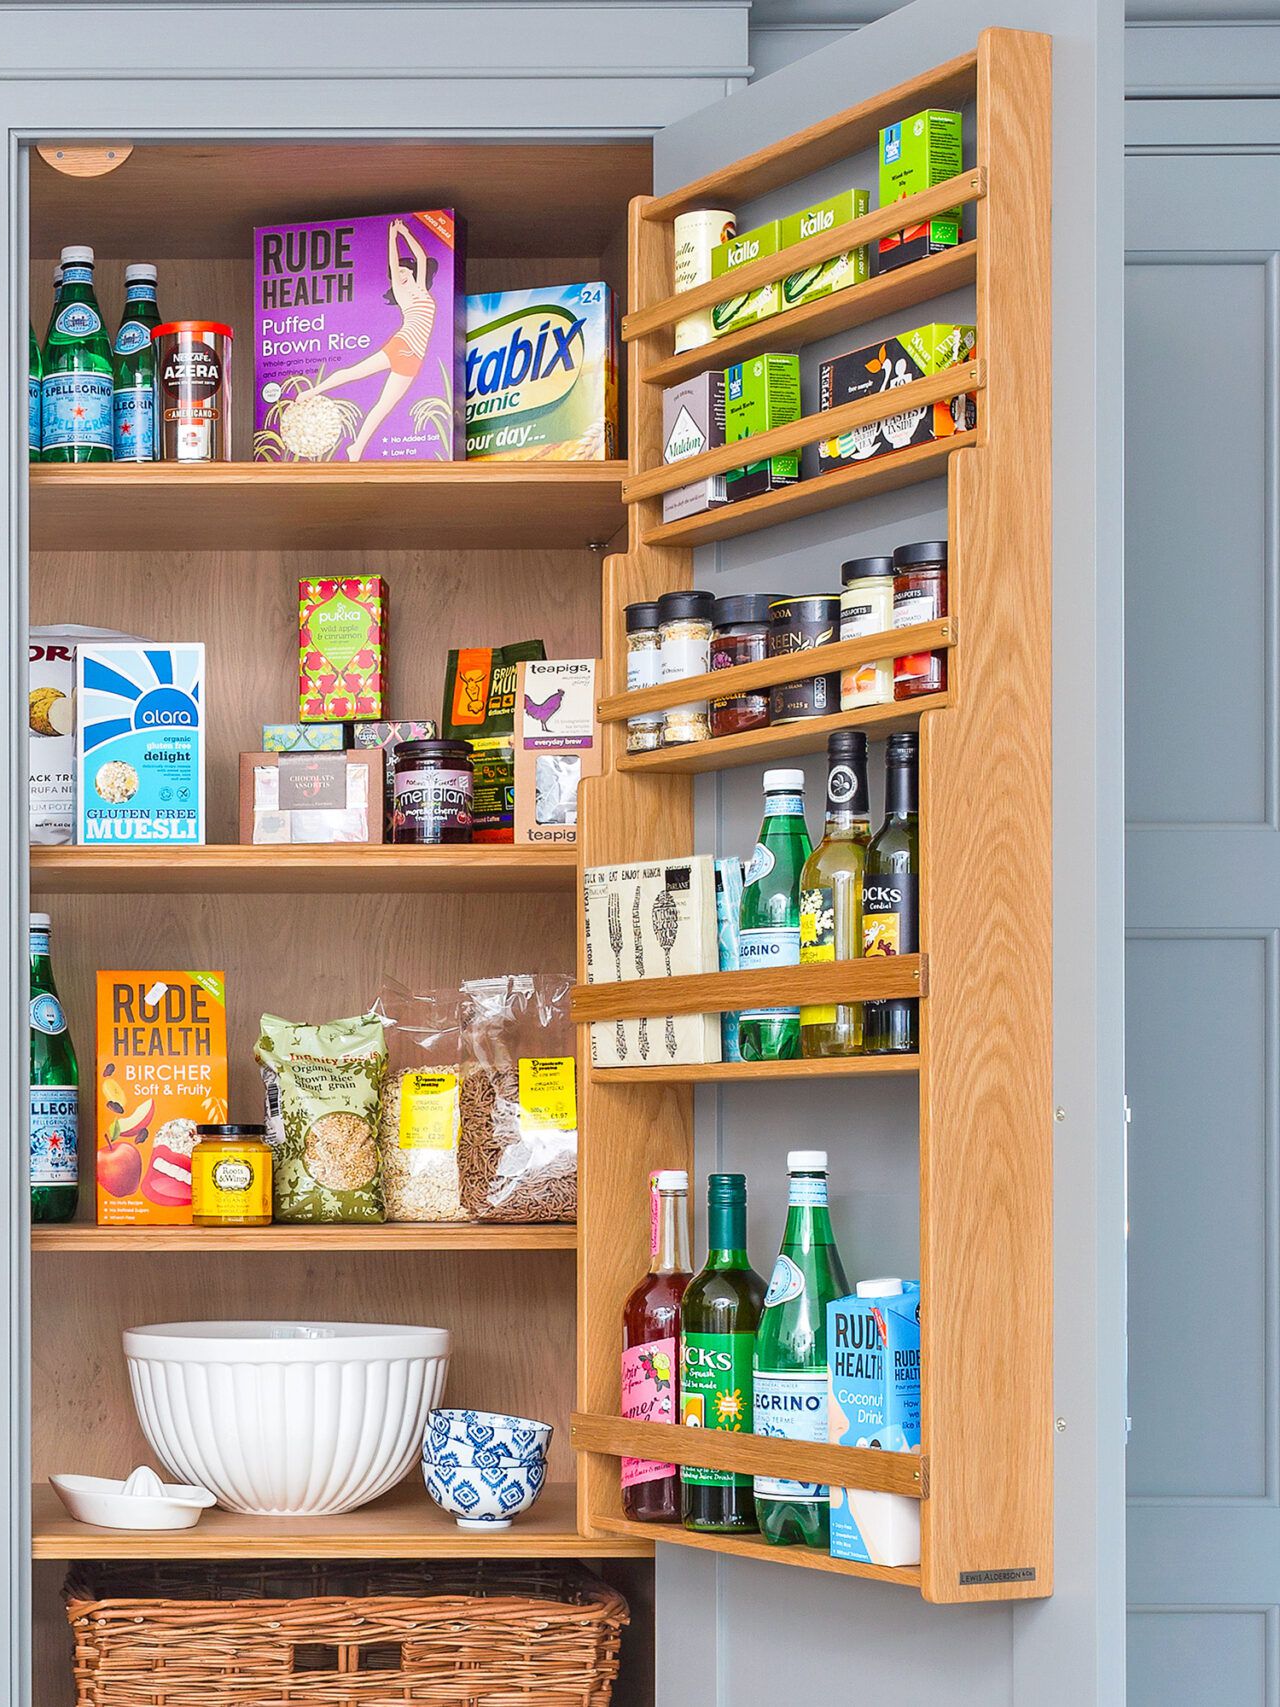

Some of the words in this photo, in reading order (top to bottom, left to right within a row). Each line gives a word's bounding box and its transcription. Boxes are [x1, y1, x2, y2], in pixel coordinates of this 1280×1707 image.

[262, 228, 354, 276] RUDE
[262, 273, 354, 310] HEALTH
[582, 290, 601, 304] 24
[262, 314, 325, 336] Puffed
[262, 338, 321, 357] Brown
[328, 333, 370, 350] Rice
[263, 357, 304, 368] Whole-grain
[305, 356, 327, 364] brown
[466, 318, 588, 400] tabix
[164, 366, 218, 380] AZERA
[262, 371, 276, 379] and
[278, 368, 304, 380] nothing
[305, 367, 319, 375] else
[45, 384, 111, 398] S.PELLEGRINO
[172, 410, 212, 418] AMERICANO
[888, 420, 912, 434] INSIDE
[670, 435, 701, 458] Maldon
[319, 611, 360, 624] pukka
[320, 625, 337, 633] wild
[338, 626, 358, 635] apple
[324, 632, 362, 640] cinnamon
[770, 632, 802, 650] REEN
[493, 664, 517, 681] GRUM
[530, 664, 591, 675] teapigs.
[490, 680, 517, 696] MUL
[142, 710, 192, 725] alara
[146, 742, 174, 751] gluten
[175, 742, 191, 750] free
[164, 736, 191, 744] organic
[534, 740, 564, 748] everyday
[564, 738, 582, 746] brew
[144, 751, 191, 762] delight
[290, 774, 335, 782] CHOCOLATS
[400, 788, 464, 806] meridian
[86, 808, 150, 819] GLUTEN
[156, 808, 196, 819] FREE
[434, 807, 458, 817] cherry
[86, 818, 197, 840] MUESLI
[609, 870, 618, 882] EAT
[622, 868, 640, 882] ENJOY
[113, 984, 210, 1024] RUDE
[114, 1027, 211, 1057] HEALTH
[289, 1052, 338, 1066] Infinity
[126, 1064, 212, 1081] BIRCHER
[292, 1064, 333, 1075] Organic
[294, 1074, 327, 1082] Brown
[330, 1074, 353, 1082] Rice
[134, 1084, 159, 1096] Soft
[163, 1084, 172, 1096] &
[177, 1084, 212, 1098] Fruity
[295, 1080, 322, 1092] Short
[328, 1080, 356, 1092] grain
[222, 1166, 244, 1176] Roots
[835, 1352, 883, 1380] HEALTH
[894, 1350, 920, 1368] RUDE
[838, 1390, 884, 1408] Coconut
[904, 1400, 918, 1408] How
[858, 1410, 884, 1424] Drink
[961, 1574, 982, 1583] LEWIS
[984, 1572, 1021, 1581] ALDERSON
